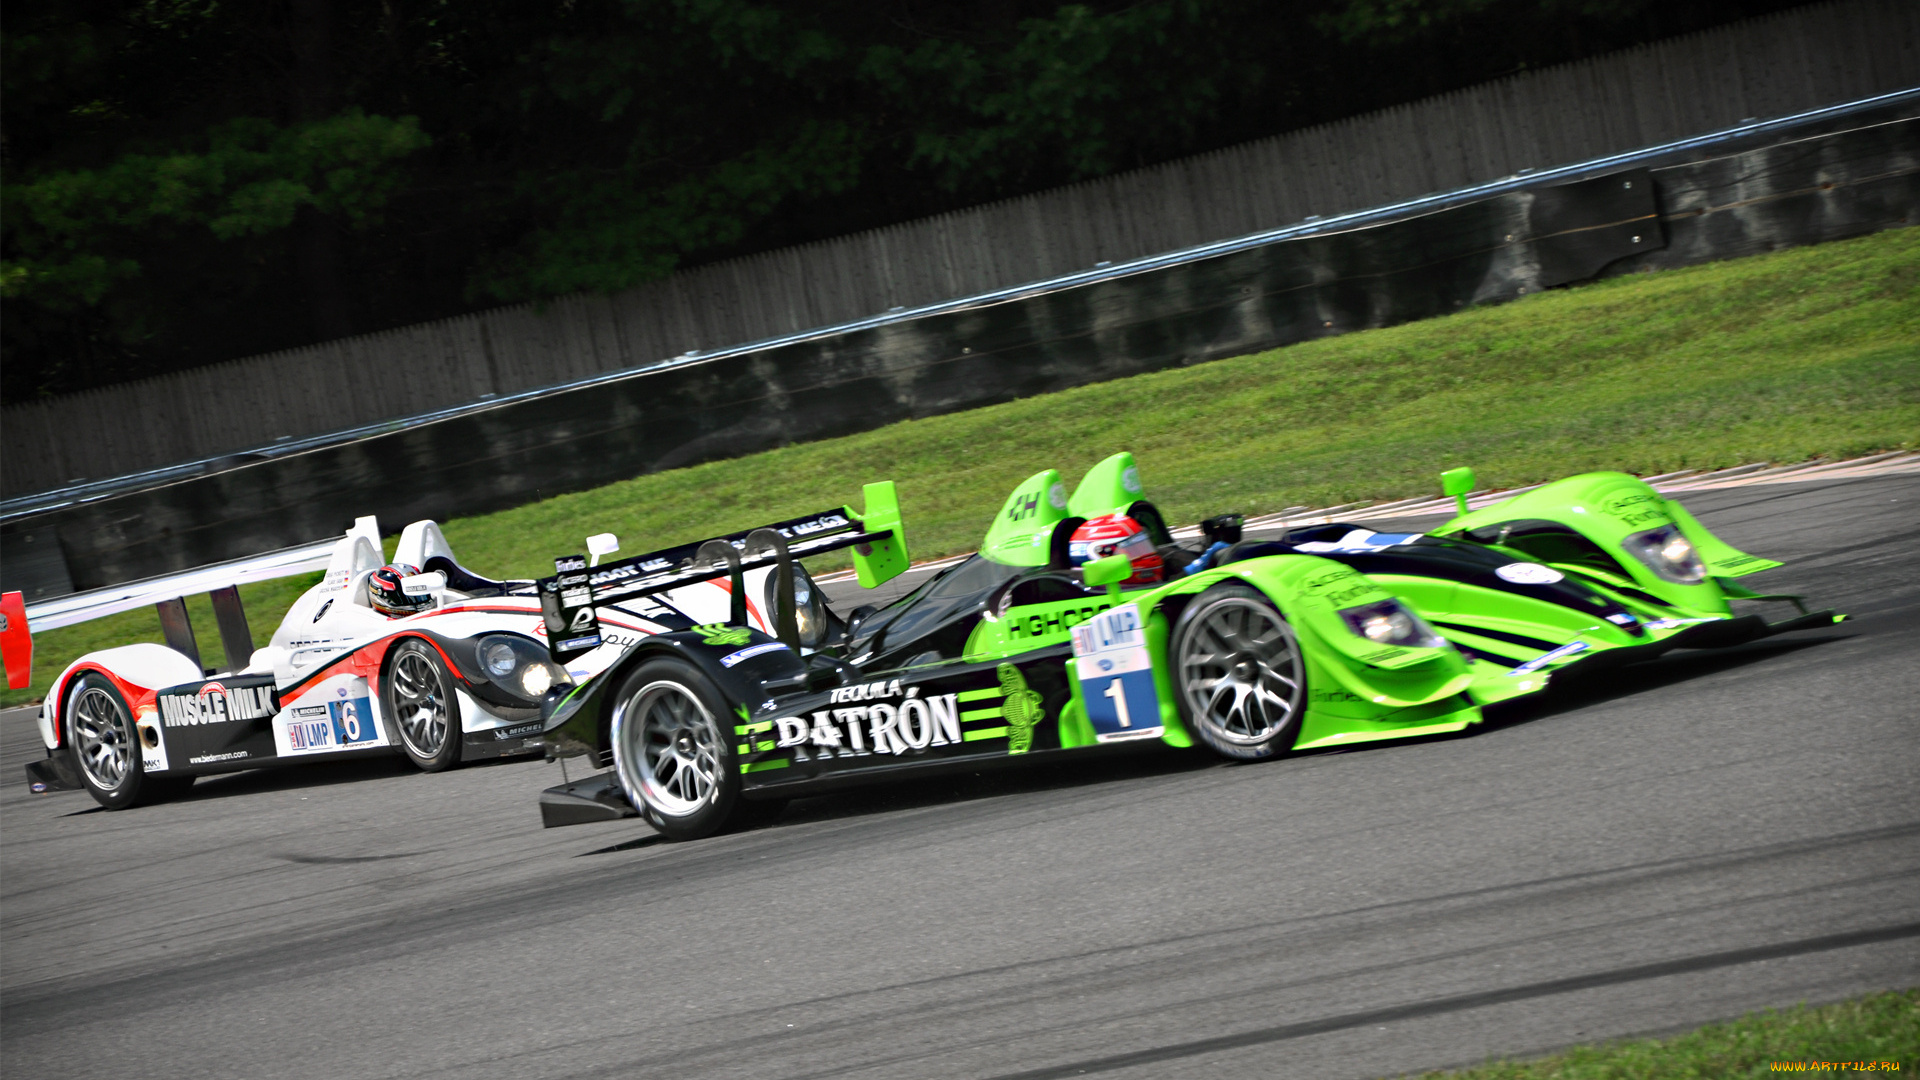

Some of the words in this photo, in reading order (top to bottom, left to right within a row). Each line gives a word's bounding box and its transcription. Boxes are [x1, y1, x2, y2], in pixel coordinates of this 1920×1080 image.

[160, 691, 227, 727] MUSCLE
[225, 686, 279, 721] MILK
[829, 679, 906, 704] TEQUILA
[1103, 677, 1132, 728] 1
[305, 722, 328, 747] LMP
[342, 701, 361, 741] 6
[509, 723, 542, 735] MICHEL
[776, 687, 962, 761] PATRÓN
